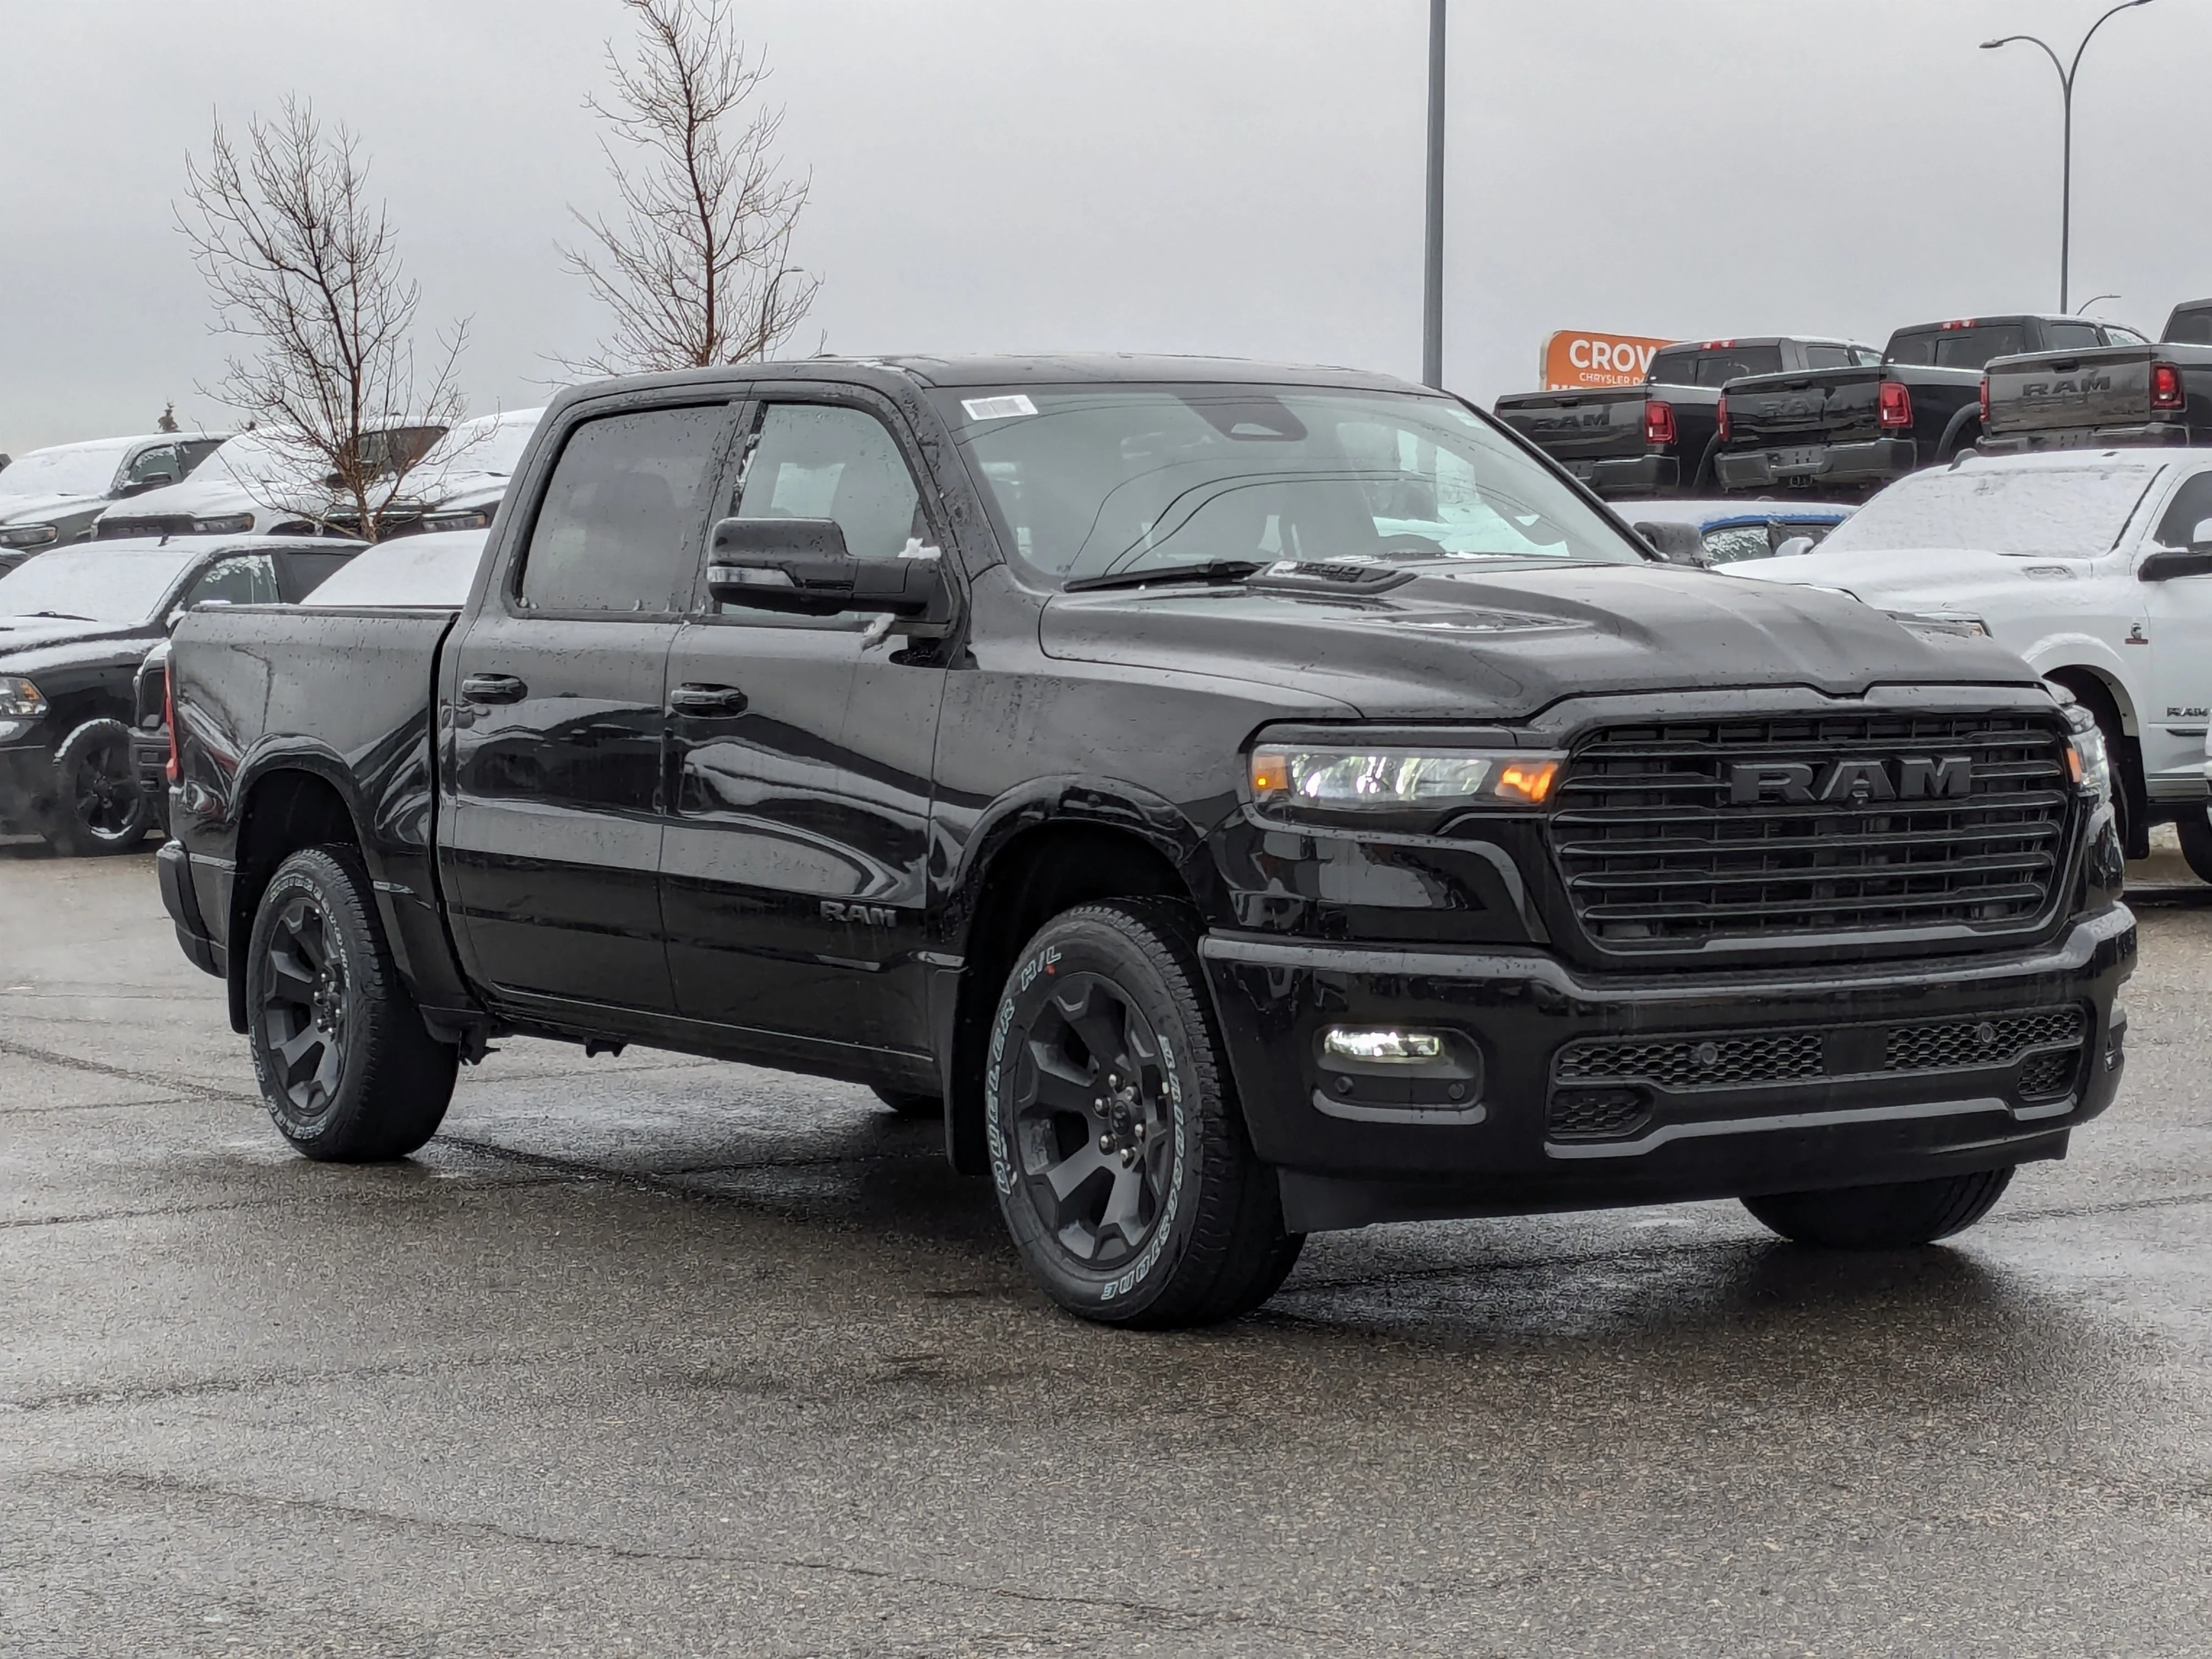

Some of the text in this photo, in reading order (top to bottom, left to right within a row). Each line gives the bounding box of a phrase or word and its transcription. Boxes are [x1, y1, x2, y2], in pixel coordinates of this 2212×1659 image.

[1579, 373, 1629, 385] CHRYSLER
[2023, 376, 2110, 396] RAM
[1534, 414, 1610, 430] RAM
[1731, 757, 1971, 803] RAM
[820, 901, 896, 928] RAM
[988, 945, 1062, 1194] DUELER H/L
[1101, 1034, 1184, 1300] BRIDGESTONE
